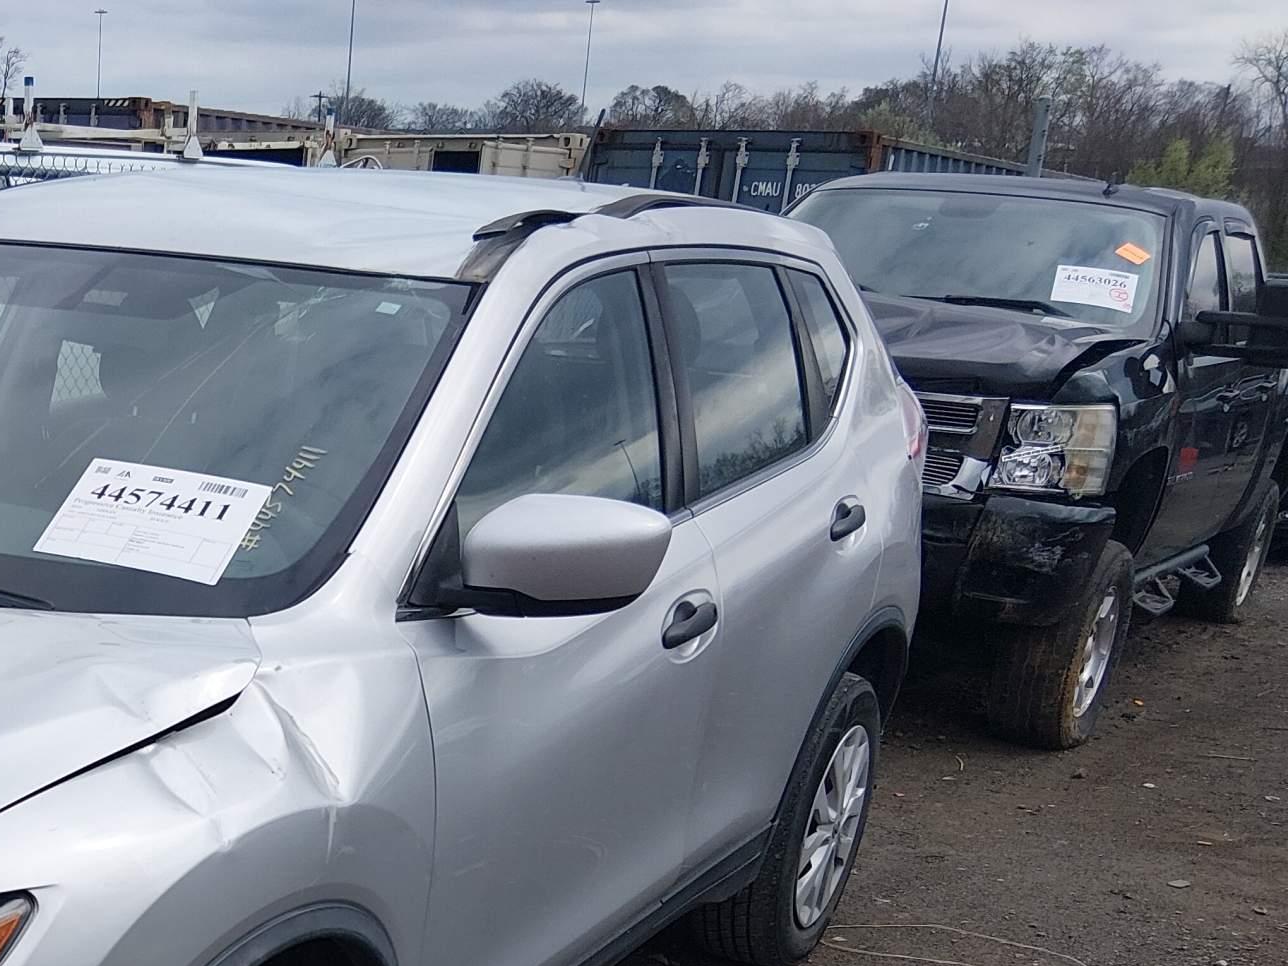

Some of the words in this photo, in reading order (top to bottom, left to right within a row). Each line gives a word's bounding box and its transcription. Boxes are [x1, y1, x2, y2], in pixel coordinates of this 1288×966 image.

[750, 181, 782, 197] CMAU
[1064, 273, 1127, 289] 44563026
[90, 483, 231, 521] 44574411
